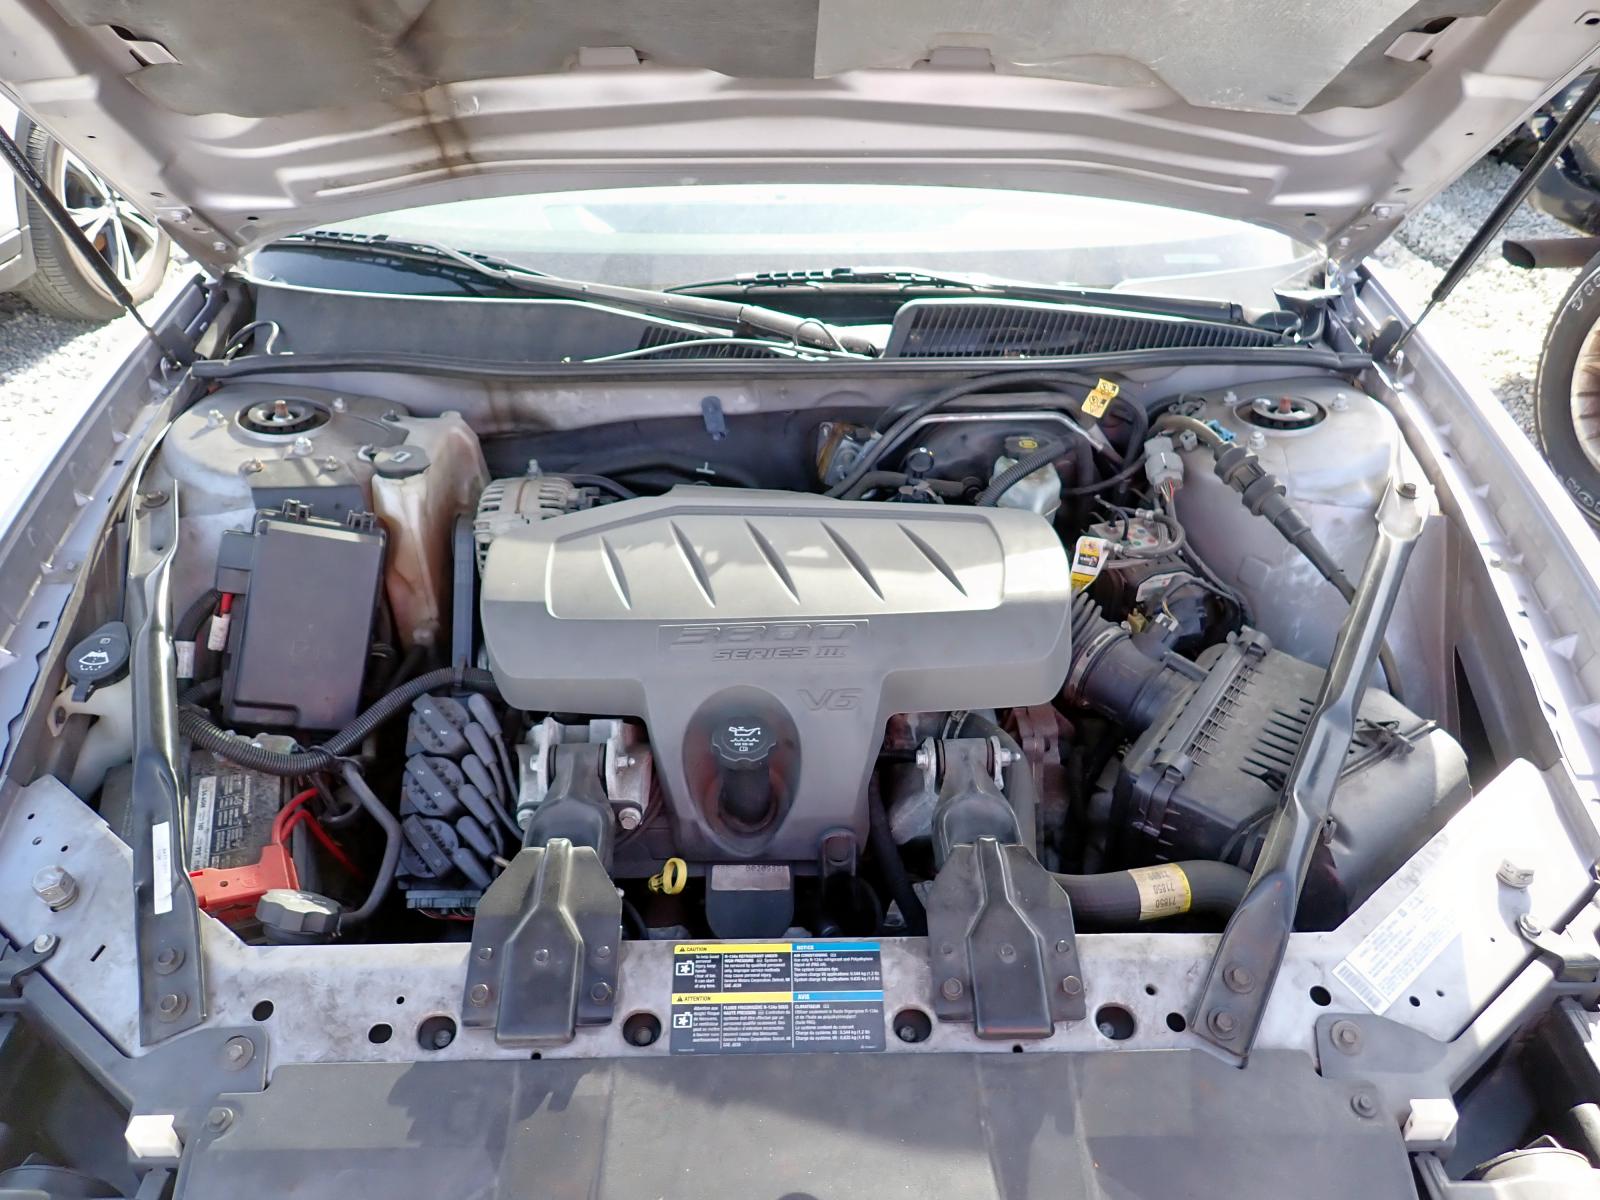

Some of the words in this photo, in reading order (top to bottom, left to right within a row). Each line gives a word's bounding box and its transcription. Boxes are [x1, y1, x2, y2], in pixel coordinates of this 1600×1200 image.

[712, 646, 810, 662] SERIES
[815, 645, 849, 658] III
[797, 687, 864, 711] V6
